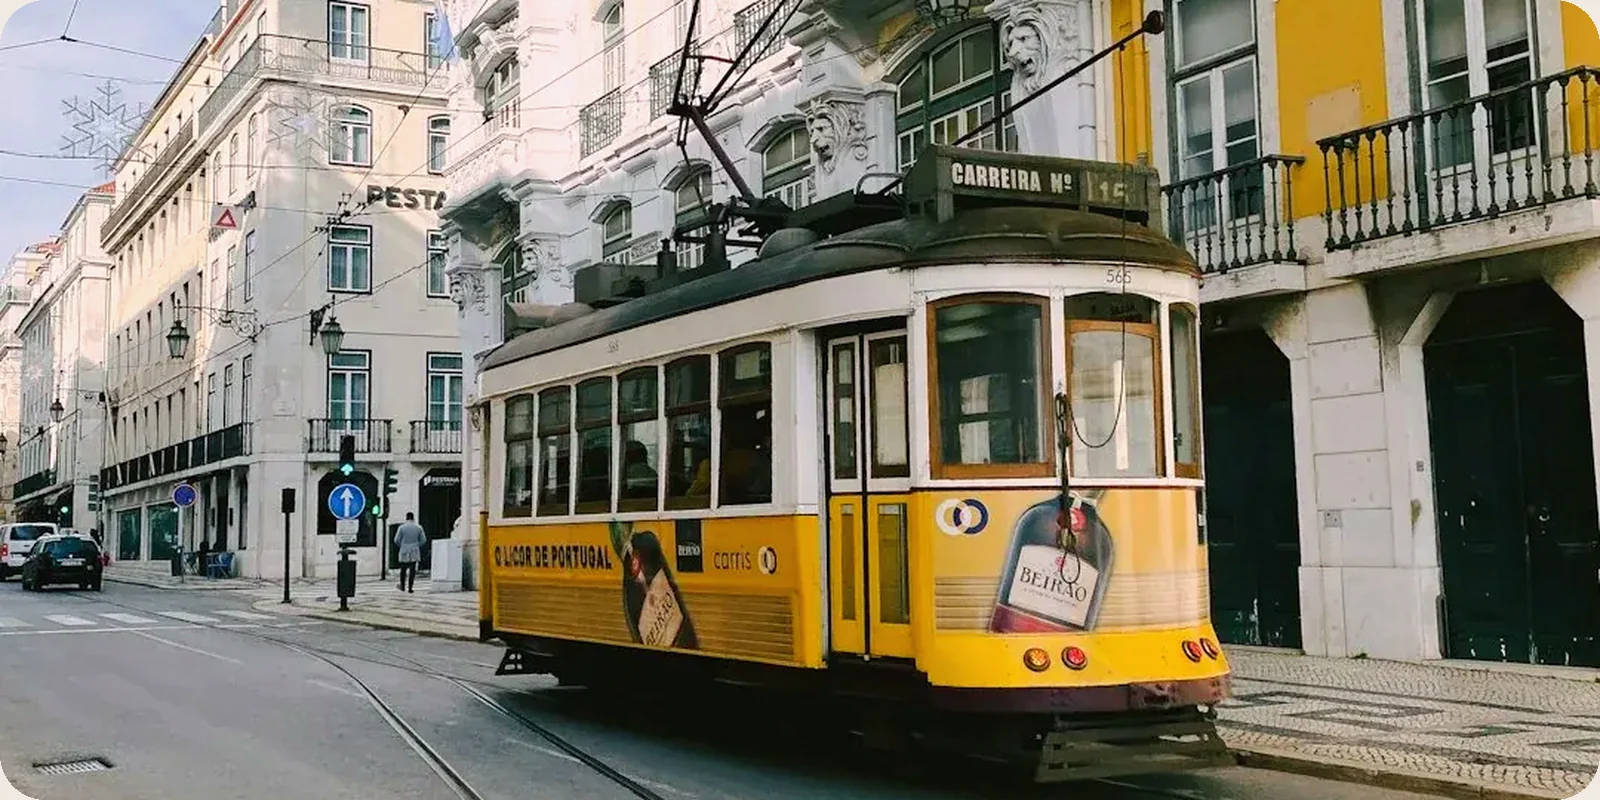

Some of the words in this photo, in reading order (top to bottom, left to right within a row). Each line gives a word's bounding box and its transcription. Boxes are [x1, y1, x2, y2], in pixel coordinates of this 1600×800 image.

[952, 162, 1041, 192] CARREIRA
[1050, 172, 1072, 194] Nº
[1106, 269, 1132, 284] 565
[494, 545, 501, 567] O
[503, 545, 532, 568] LICOR
[534, 545, 549, 569] DE
[551, 545, 613, 570] PORTUGAL
[713, 543, 752, 570] carris
